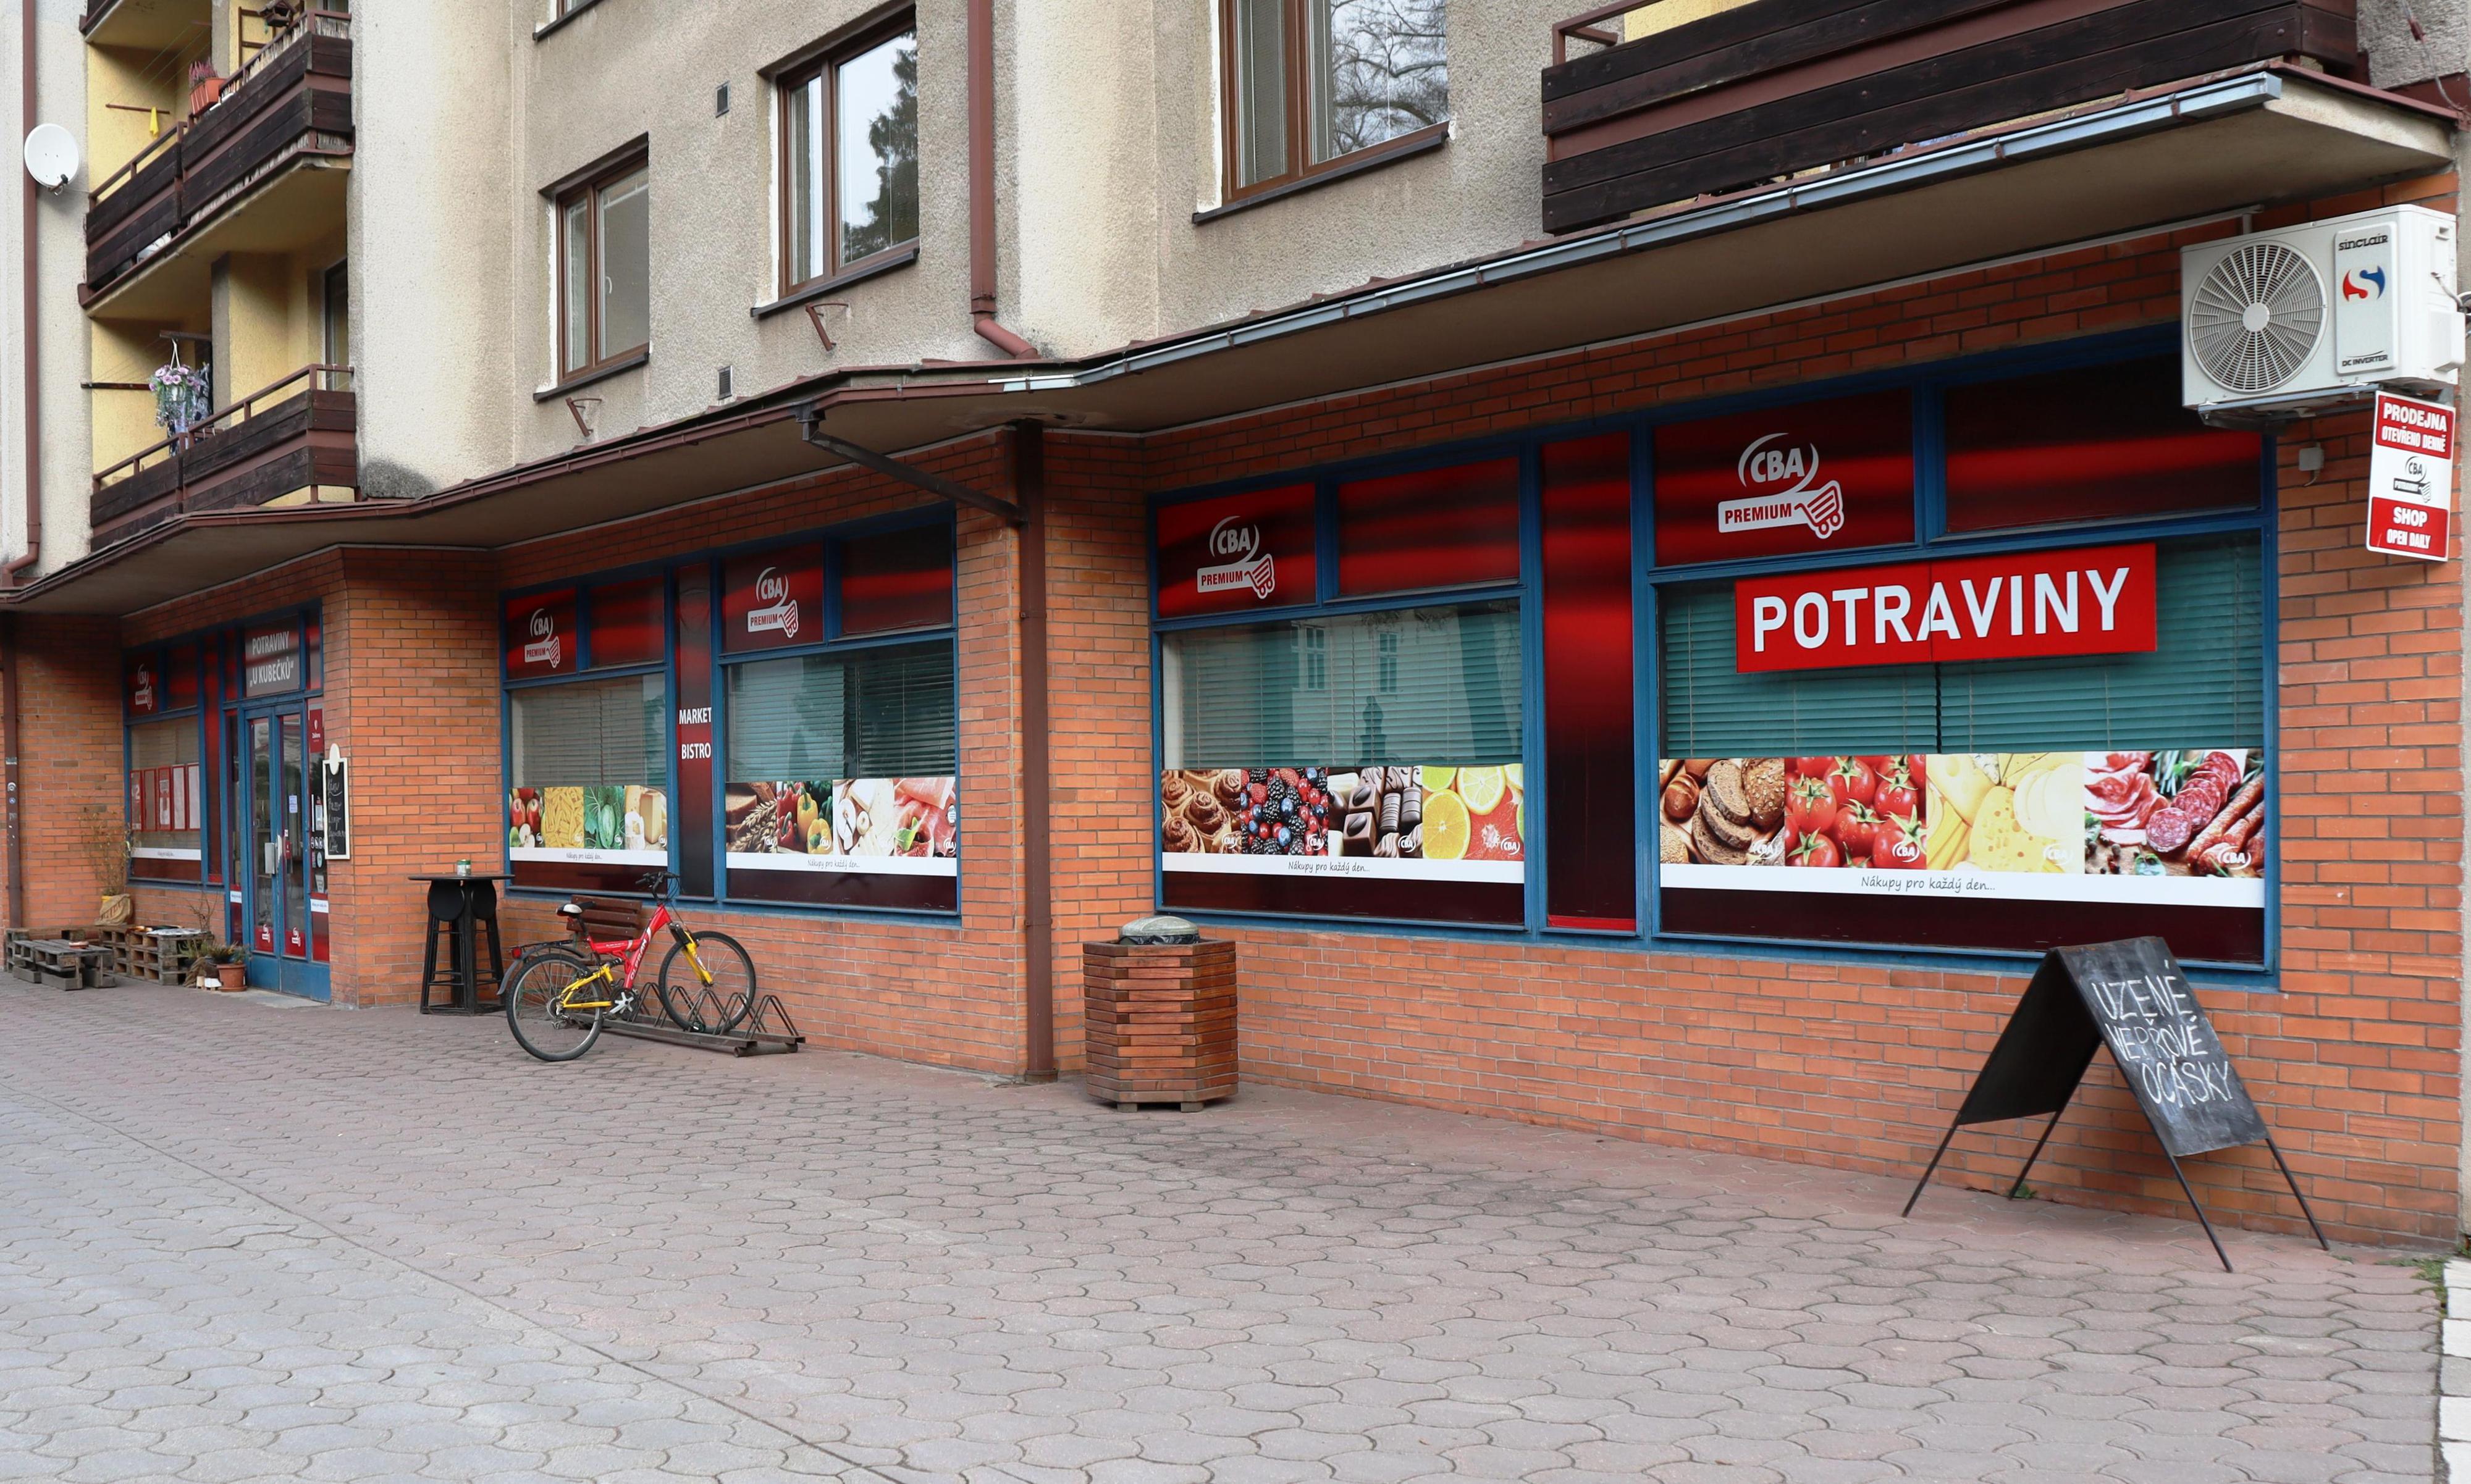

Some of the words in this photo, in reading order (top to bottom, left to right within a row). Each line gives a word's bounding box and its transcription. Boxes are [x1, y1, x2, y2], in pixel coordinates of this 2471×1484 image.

[2353, 354, 2388, 365] INVERTER
[2383, 402, 2448, 432] PRODEJNA
[2381, 425, 2421, 447] OTEVŘENO
[2422, 435, 2446, 453] DENNĚ
[1751, 448, 1805, 483] CBA
[2409, 463, 2423, 476] CBA
[1725, 503, 1791, 524] PREMIUM
[2393, 506, 2428, 527] SHOP
[1217, 528, 1251, 554] CBA
[2386, 529, 2408, 546] OPEN
[2409, 532, 2431, 549] DAILY
[761, 577, 783, 600] CBA
[1202, 571, 1243, 586] PREMIUM
[1753, 567, 2131, 652] POTRAVINY
[533, 618, 549, 636] CBA
[750, 614, 778, 626] PREMIUM
[252, 631, 289, 655] POTRAVINY
[526, 647, 546, 658] PREMIUM
[679, 707, 712, 724] MARKET
[681, 742, 712, 760] BISTRO
[1896, 845, 1916, 857] CBA
[2223, 852, 2246, 864] CBA
[807, 859, 824, 869] Nákupy
[825, 861, 833, 869] pro
[835, 859, 848, 870] každý
[1288, 860, 1313, 873] Nákupy
[1316, 863, 1327, 874] pro
[1329, 861, 1350, 874] každý
[1861, 876, 1901, 892] Nákupy
[1906, 880, 1925, 893] pro
[1929, 878, 1961, 893] každý
[630, 938, 647, 980] OLPRAN
[2091, 959, 2193, 1020] UZENÉ
[2105, 1015, 2208, 1061] VEPŘOVÉ
[2142, 1055, 2233, 1109] OCÁSKY
